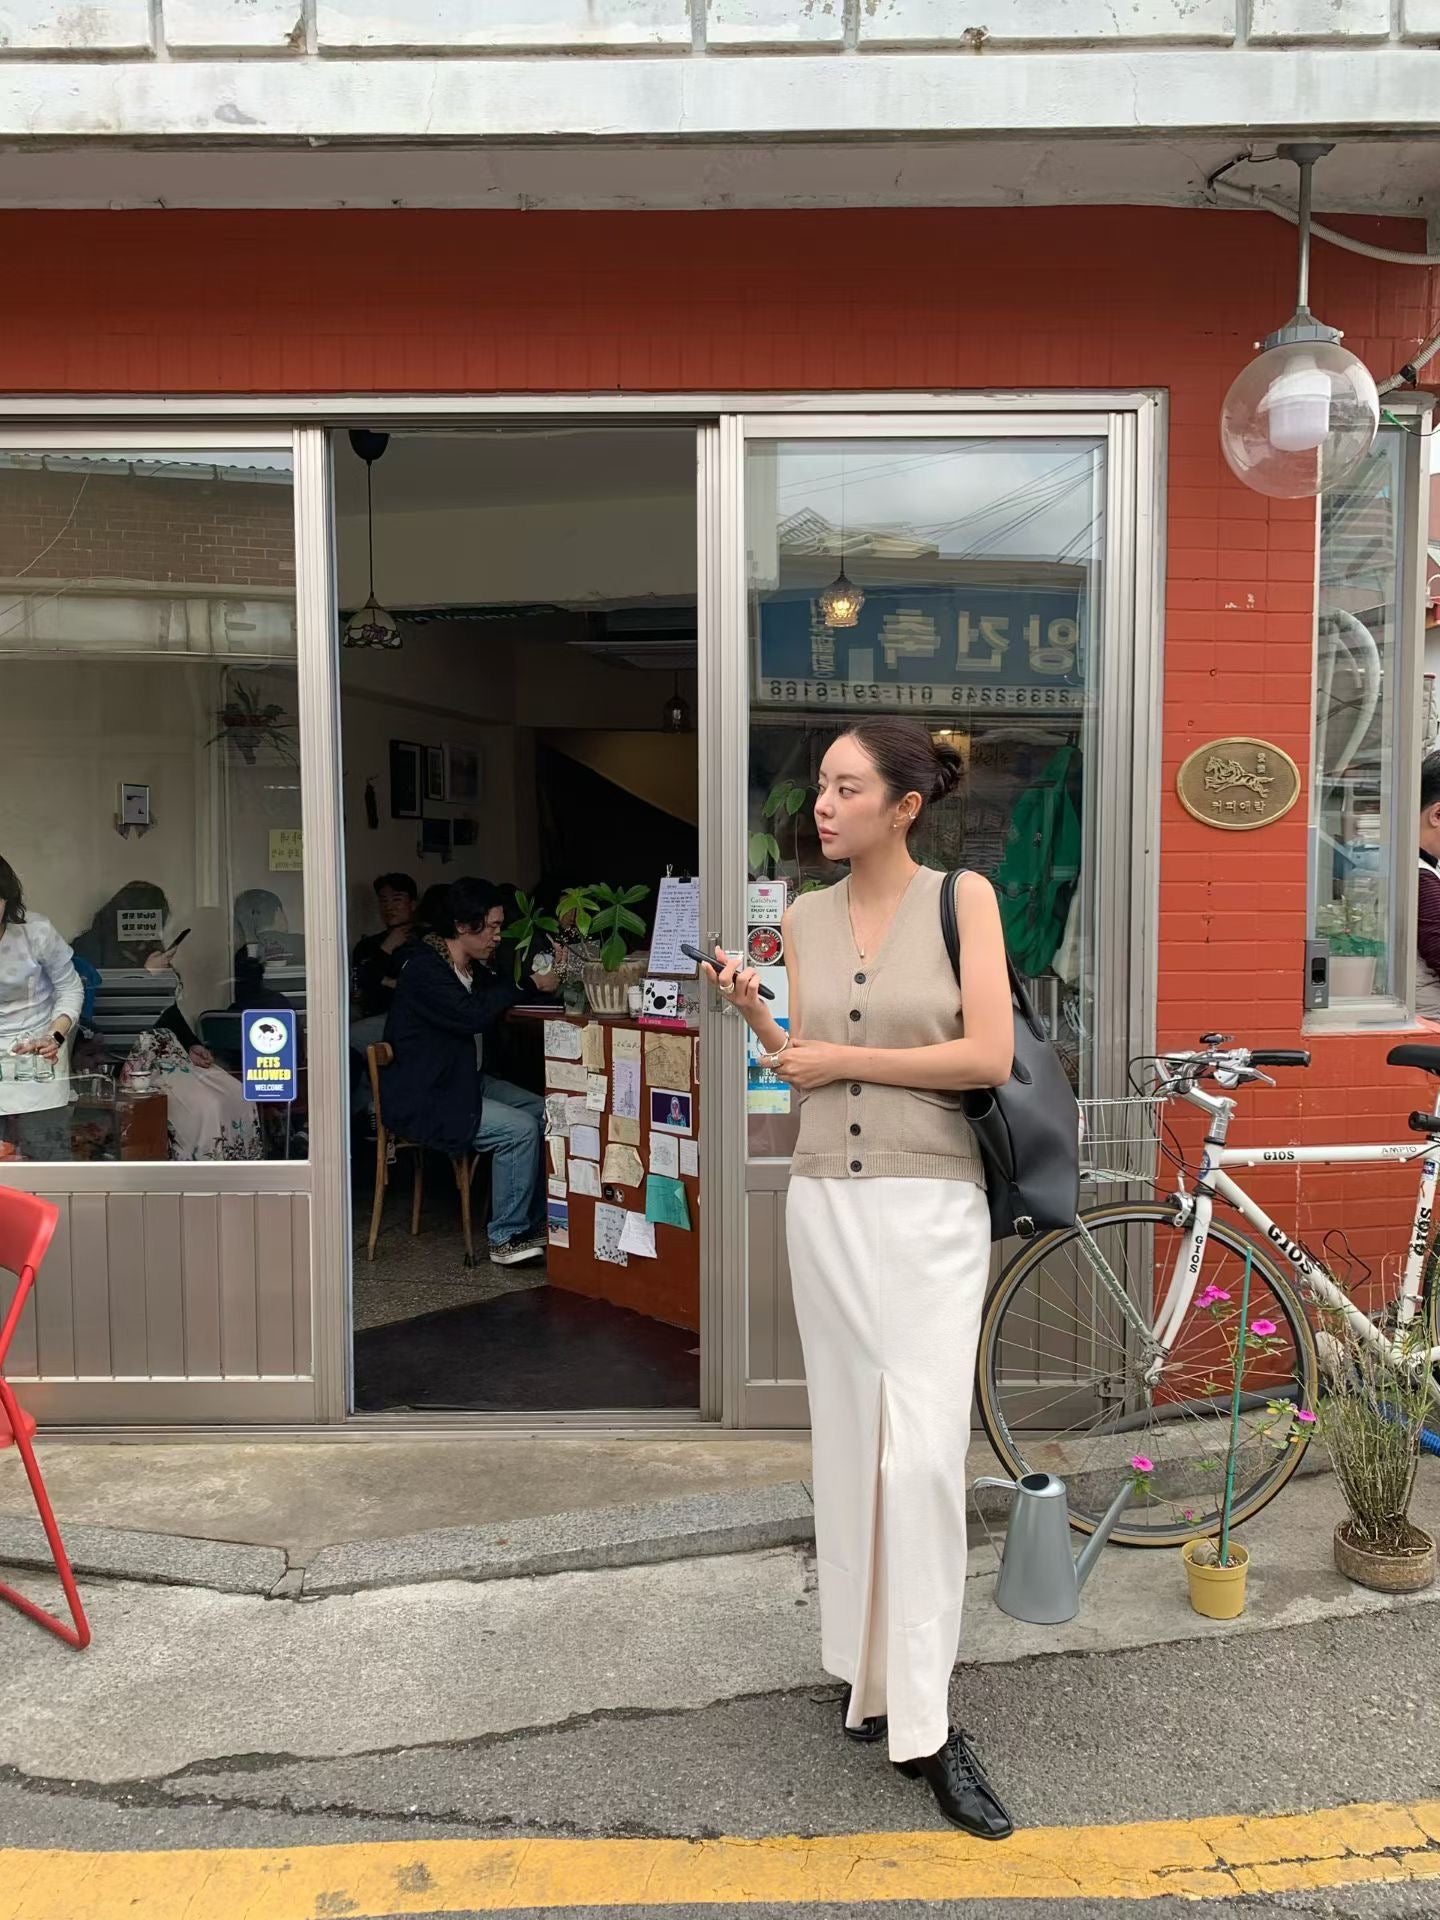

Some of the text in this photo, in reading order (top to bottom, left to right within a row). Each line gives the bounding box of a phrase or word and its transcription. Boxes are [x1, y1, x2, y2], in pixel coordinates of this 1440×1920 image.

[256, 1056, 281, 1068] PETS
[247, 1069, 291, 1081] ALLOWED
[254, 1083, 284, 1091] WELCOME
[1263, 1151, 1295, 1161] GIOS
[1412, 1207, 1433, 1256] GIOS
[1189, 1236, 1204, 1273] GIOS
[1267, 1223, 1313, 1275] GIOS
